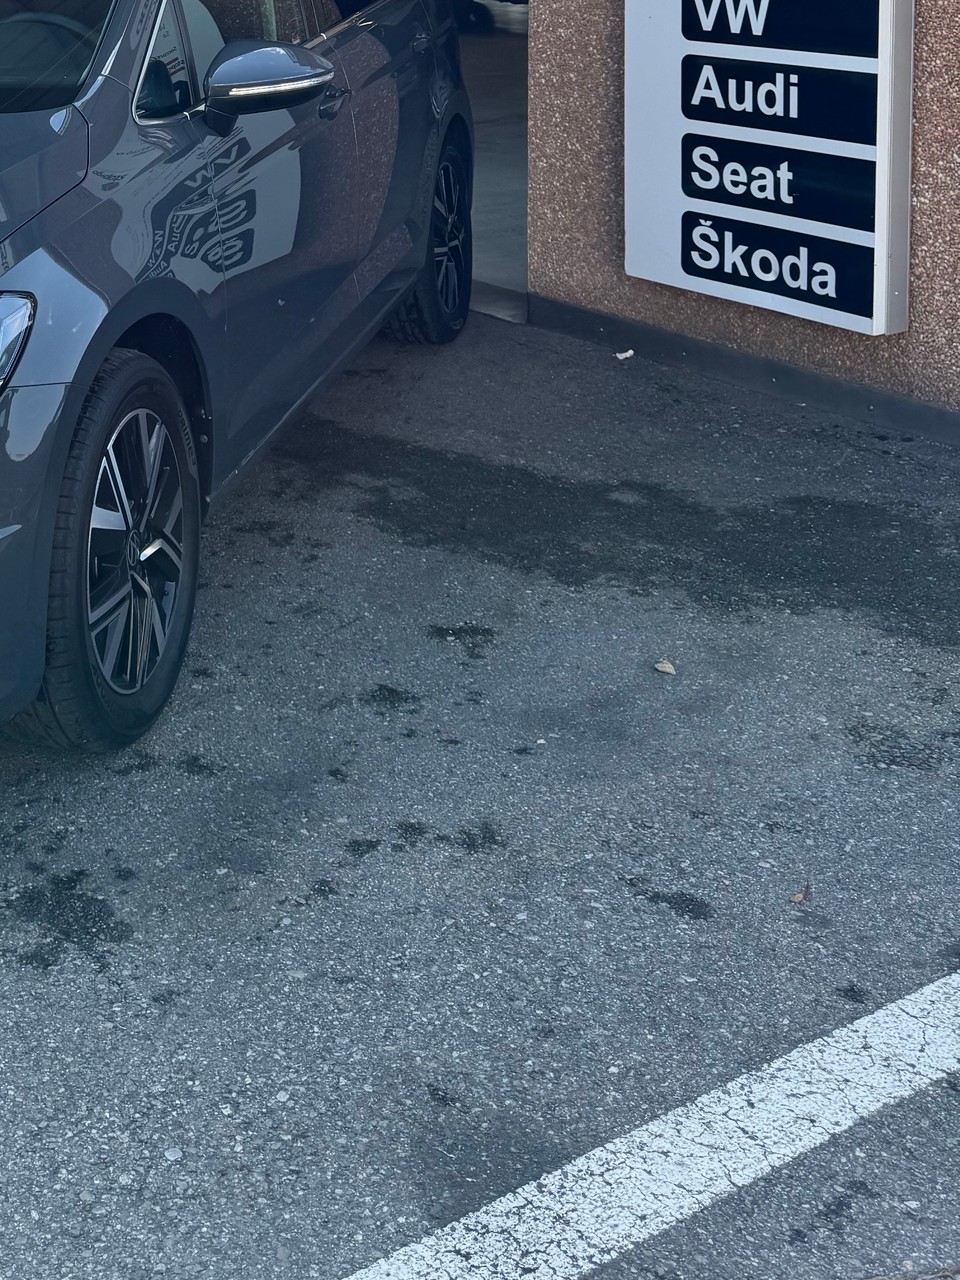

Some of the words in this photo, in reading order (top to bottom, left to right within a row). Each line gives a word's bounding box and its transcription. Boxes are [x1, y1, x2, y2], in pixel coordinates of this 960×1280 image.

[690, 64, 799, 119] Audi
[690, 146, 794, 204] Seat
[690, 218, 837, 298] Škoda
